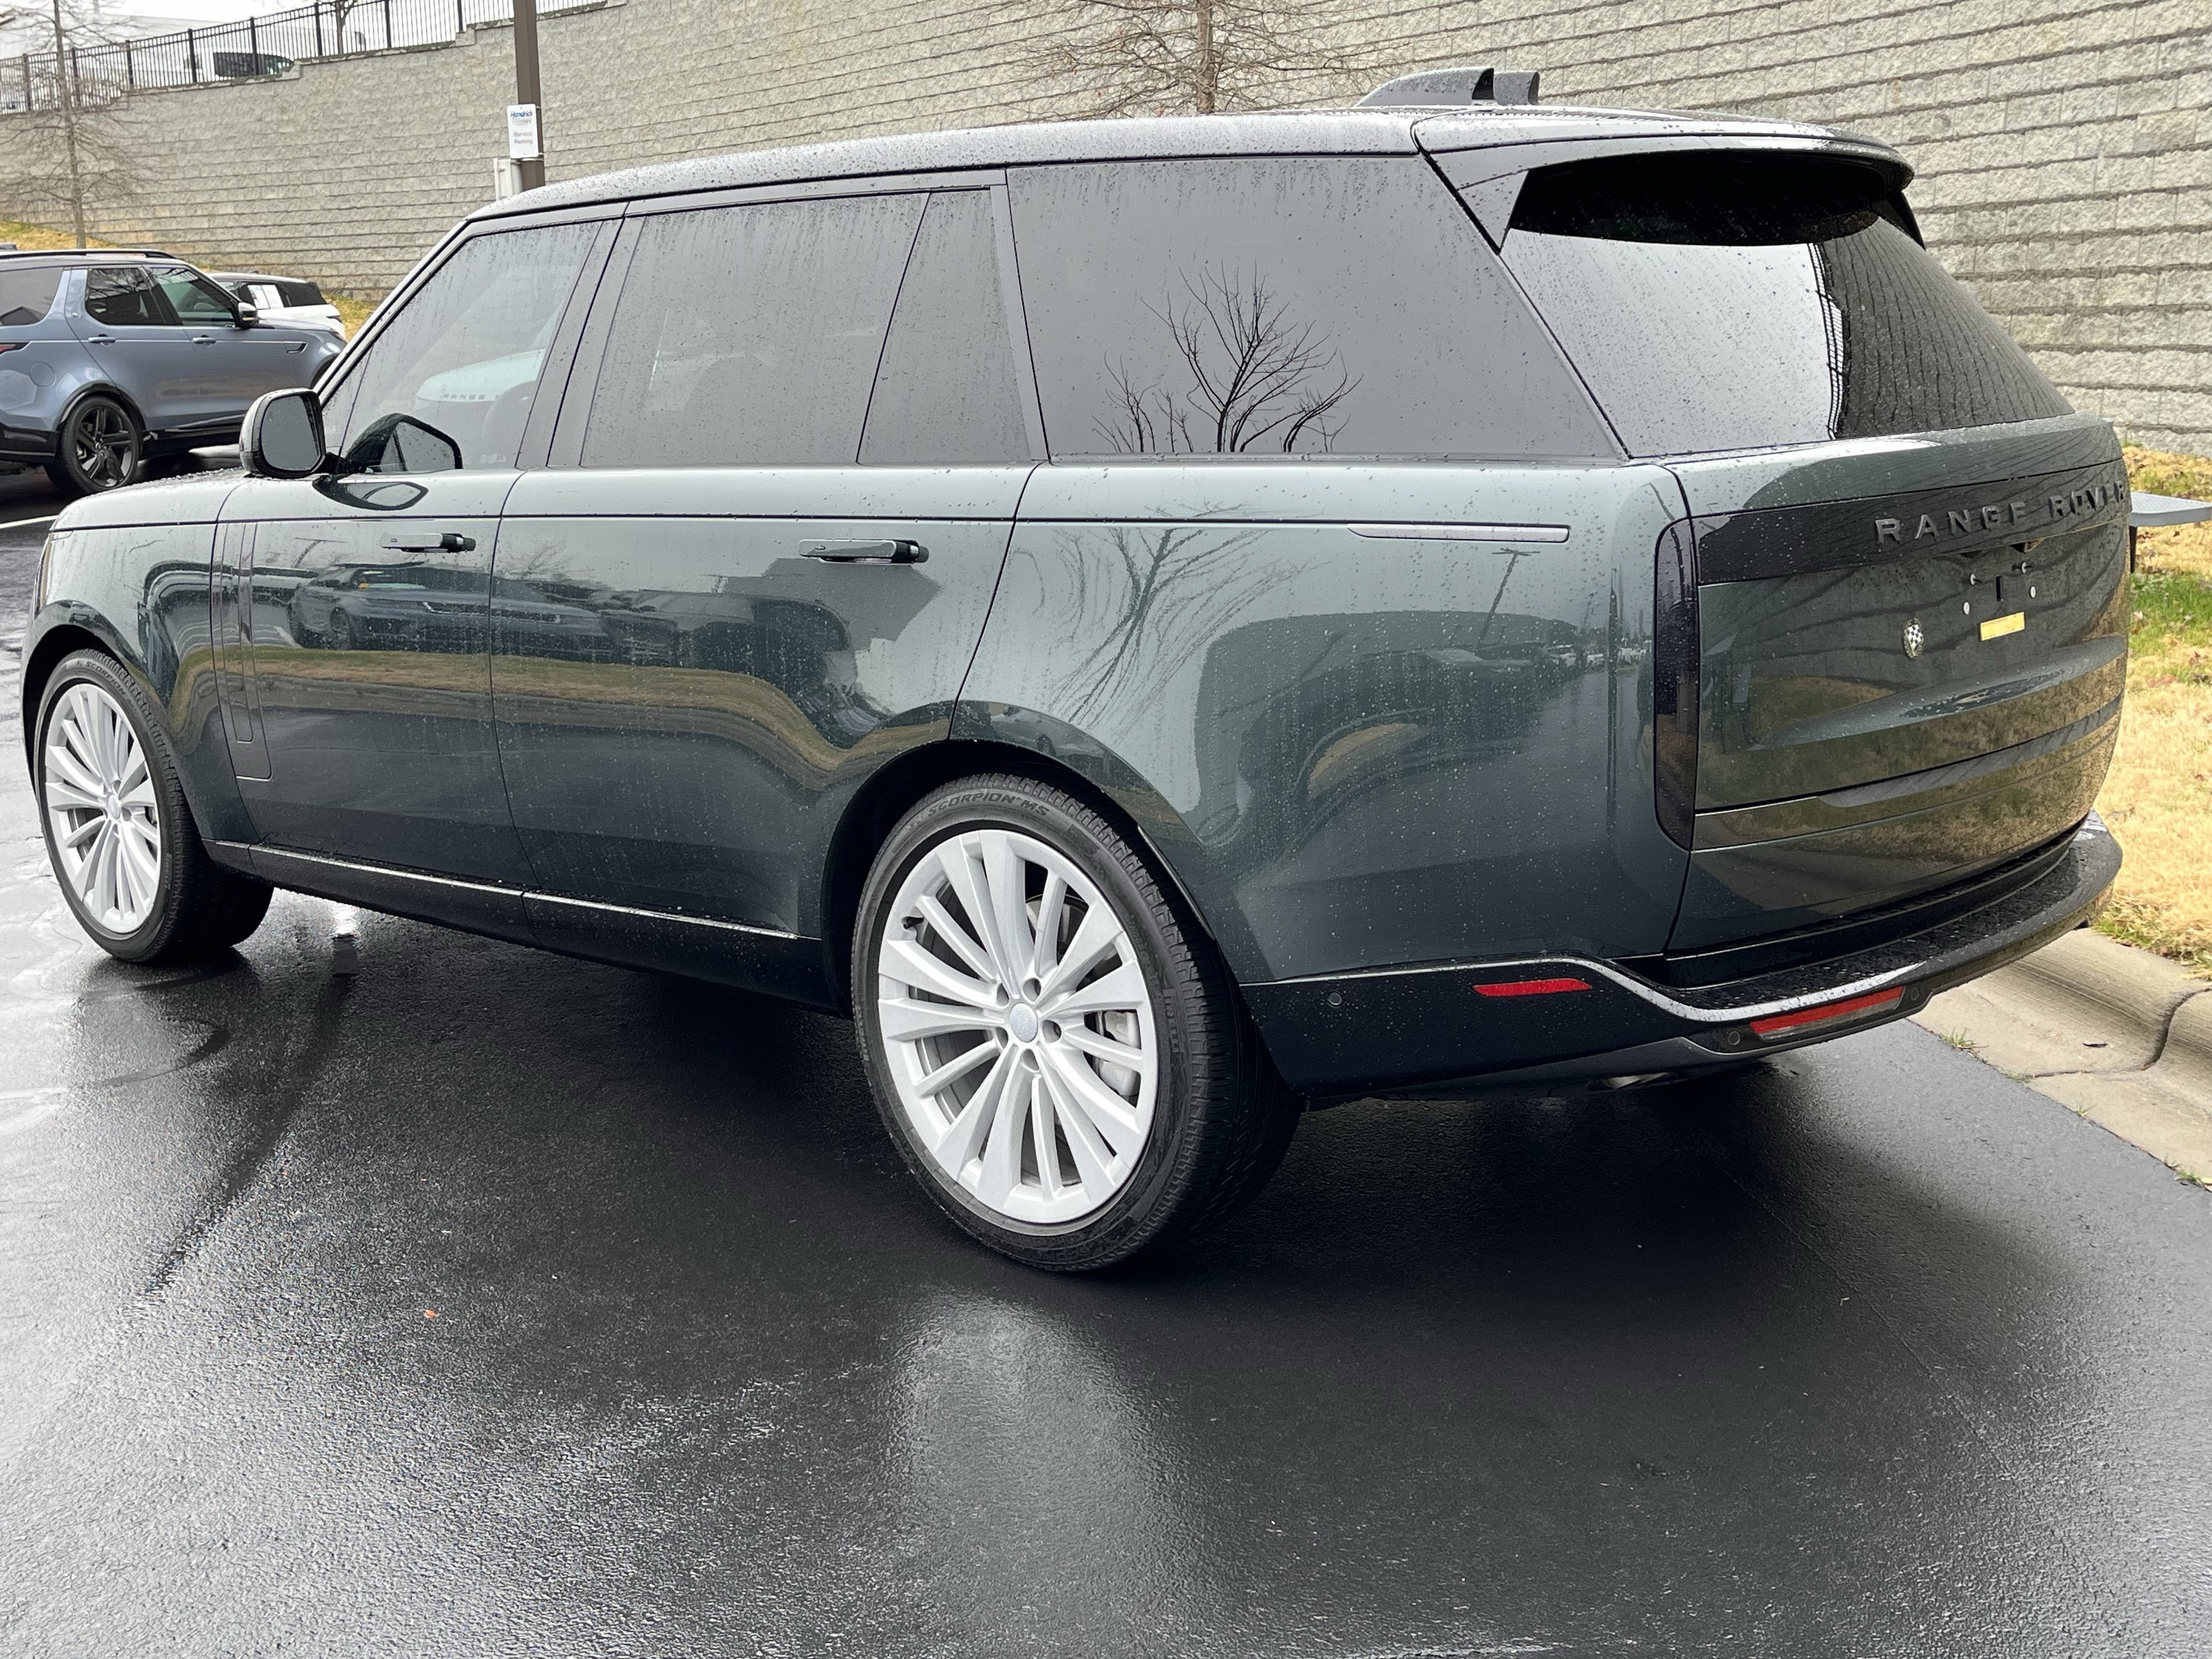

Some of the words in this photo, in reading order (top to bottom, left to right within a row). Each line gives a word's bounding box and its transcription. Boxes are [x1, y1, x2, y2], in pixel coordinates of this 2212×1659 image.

[1875, 501, 2028, 545] RANGE
[86, 661, 127, 696] SCORPION
[927, 792, 1016, 817] SCORPION
[1020, 799, 1051, 817] MS
